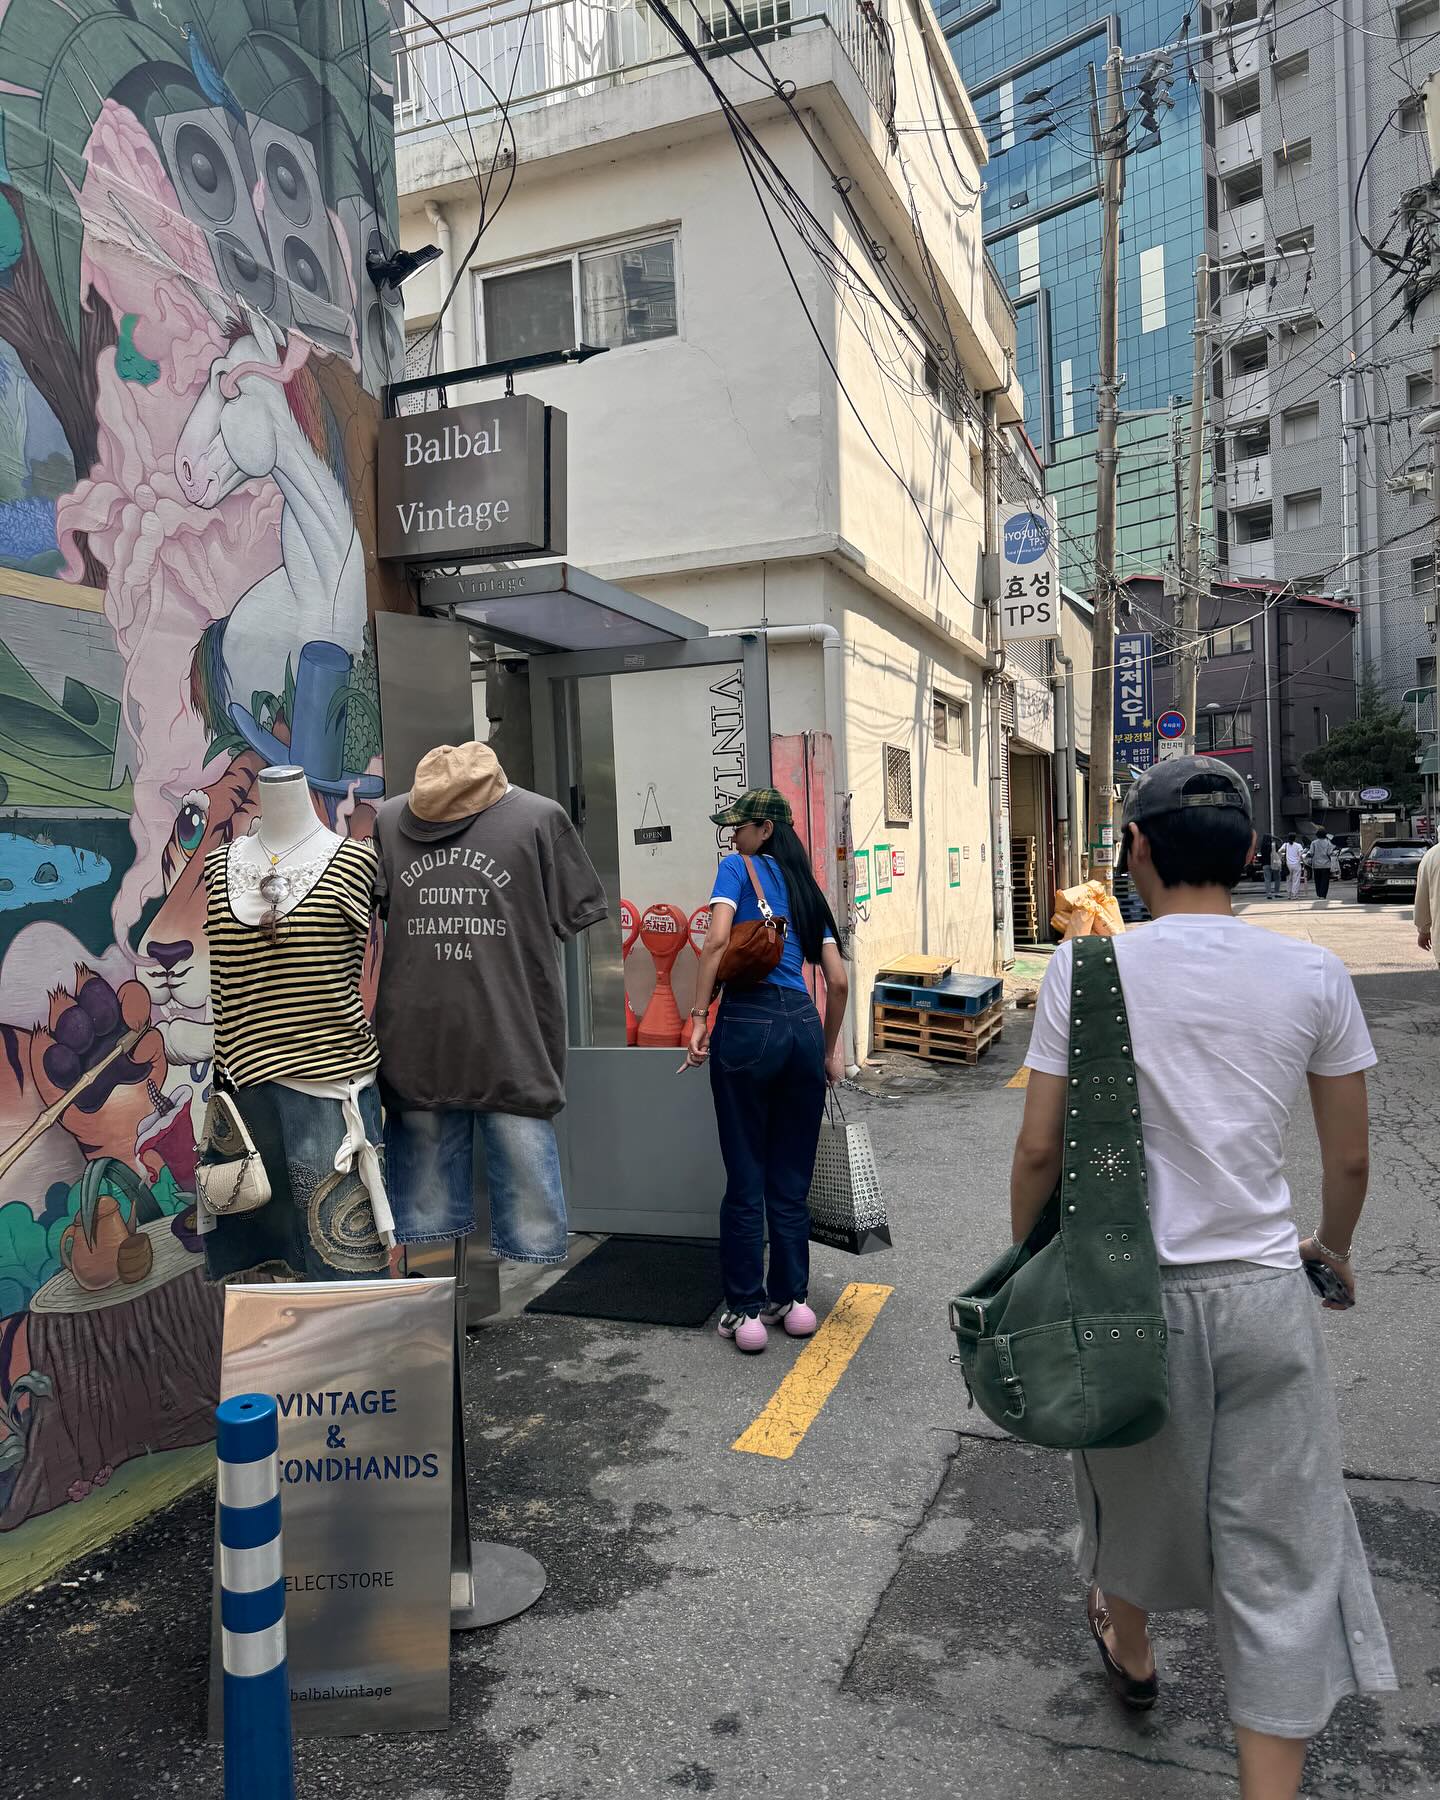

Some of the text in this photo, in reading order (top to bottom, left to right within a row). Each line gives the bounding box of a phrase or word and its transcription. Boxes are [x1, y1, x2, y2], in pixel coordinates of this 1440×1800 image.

[404, 419, 502, 467] Balbal
[396, 499, 510, 535] Vintage
[1029, 537, 1045, 547] TPS
[458, 576, 526, 593] Vintage
[1004, 571, 1050, 599] 효성
[1004, 602, 1051, 626] TPS
[643, 831, 663, 839] OPEN
[400, 847, 512, 888] GOODFIELD
[419, 887, 490, 906] COUNTY
[407, 917, 507, 937] CHAMPIONS
[645, 919, 674, 932] 주차금지
[434, 942, 473, 961] 1964
[276, 1389, 397, 1417] VINTAGE
[326, 1424, 346, 1449] &
[279, 1453, 439, 1484] ONDHANDS
